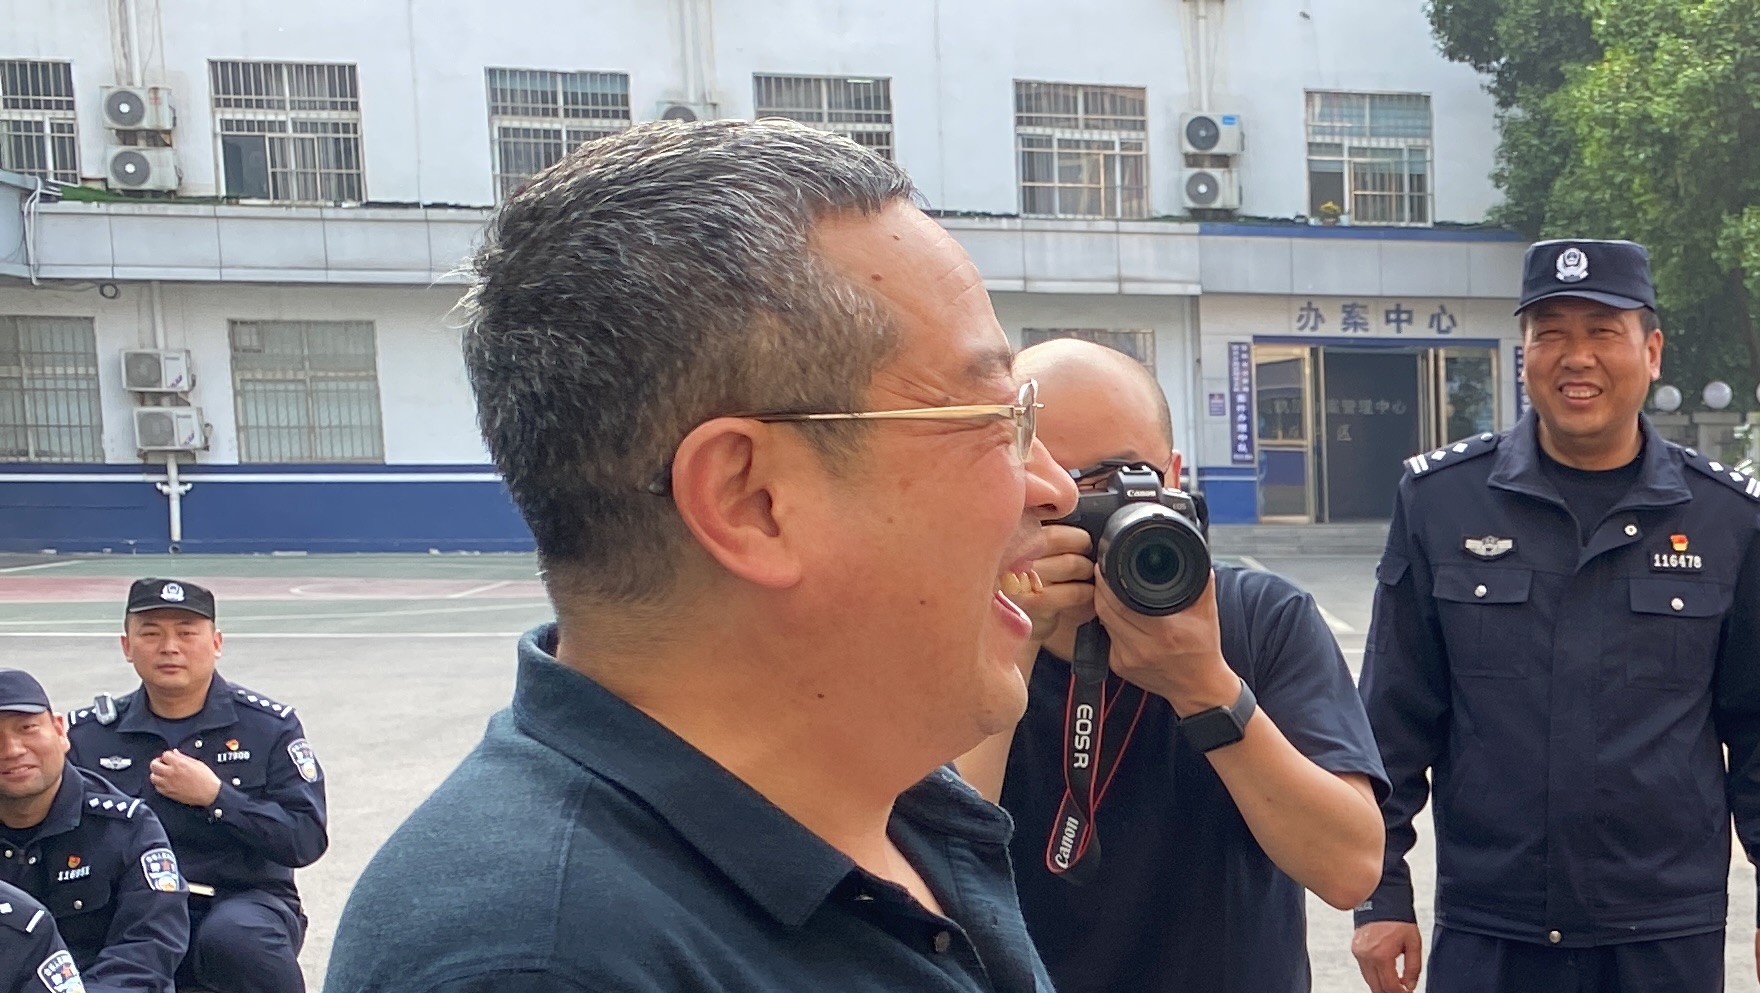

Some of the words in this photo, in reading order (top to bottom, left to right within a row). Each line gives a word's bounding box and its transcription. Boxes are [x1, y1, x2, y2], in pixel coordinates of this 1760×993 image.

[1296, 300, 1458, 335] 办案中心
[1653, 553, 1702, 569] 116478
[1074, 703, 1094, 751] EOS
[1073, 751, 1090, 769] R
[1054, 815, 1080, 870] Canon
